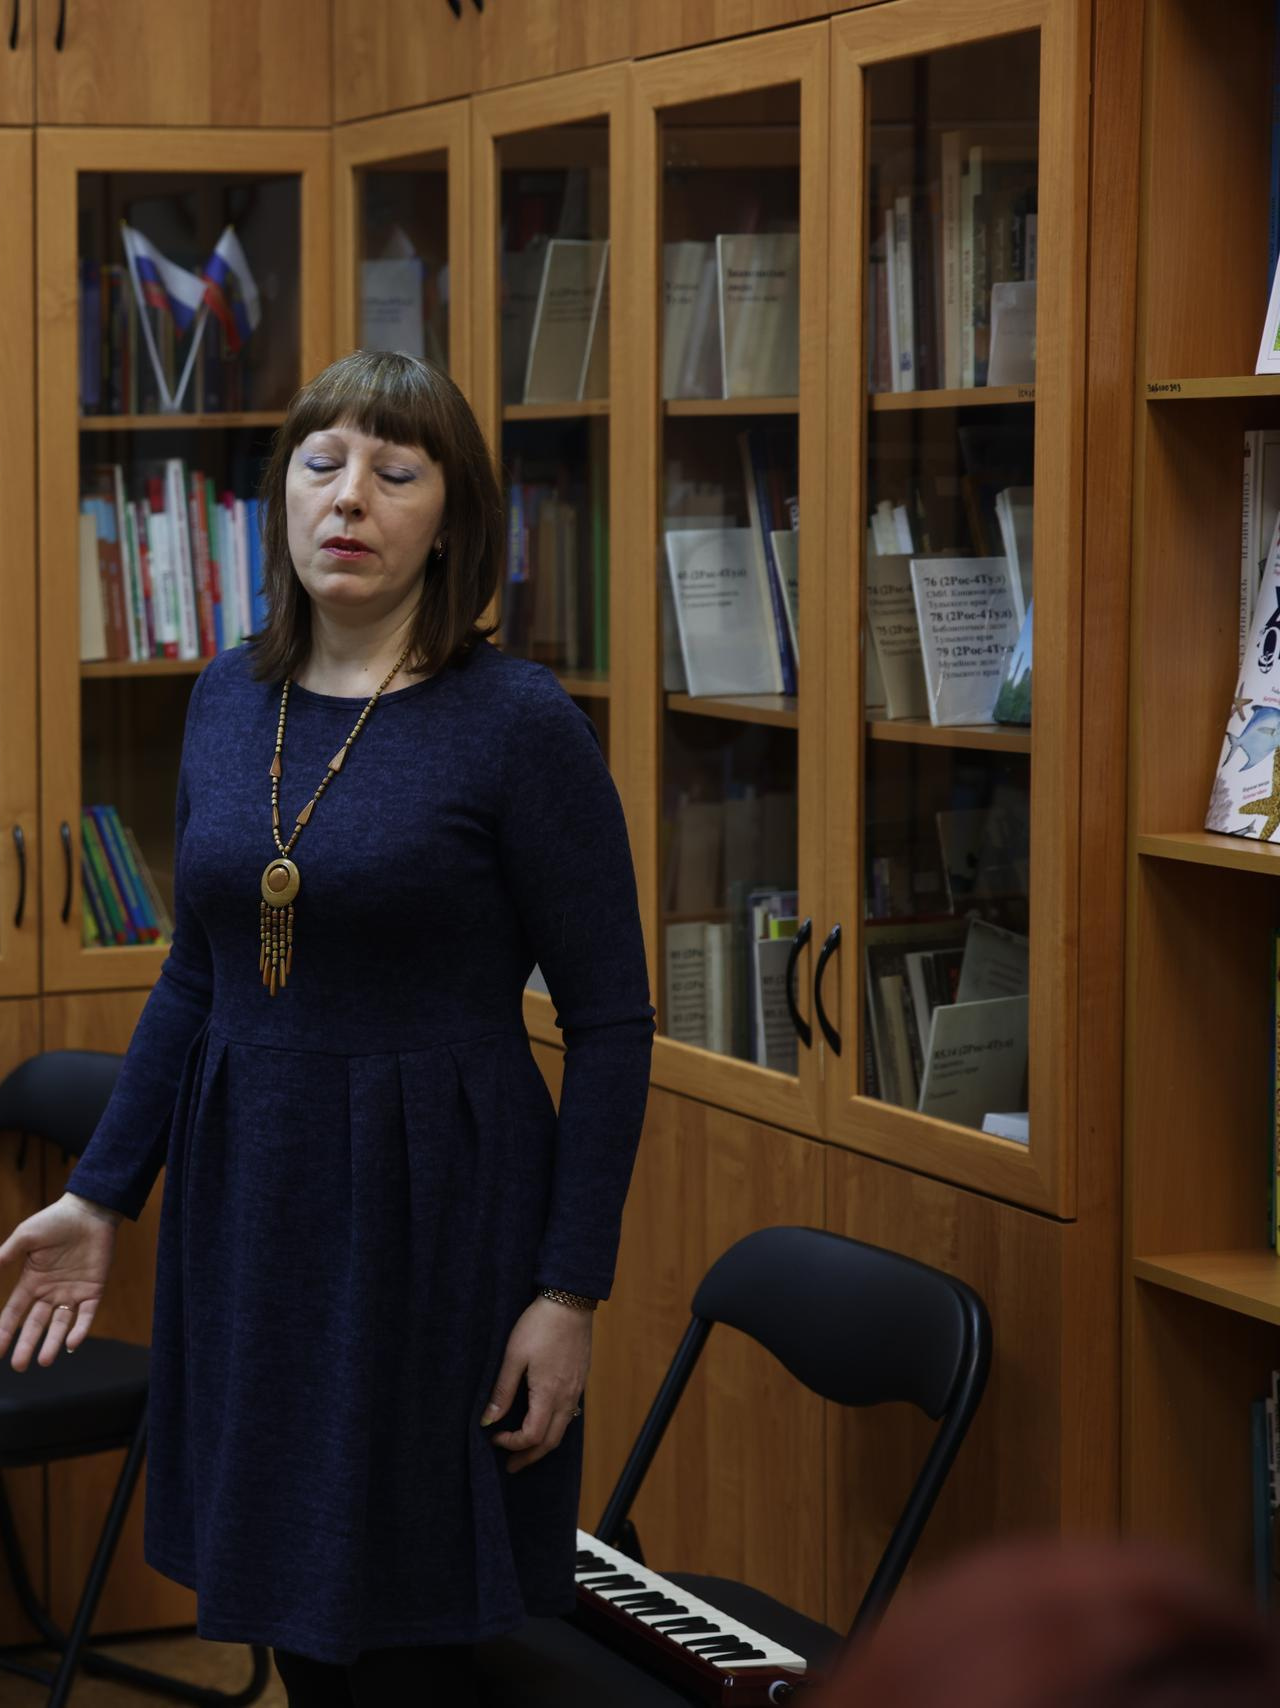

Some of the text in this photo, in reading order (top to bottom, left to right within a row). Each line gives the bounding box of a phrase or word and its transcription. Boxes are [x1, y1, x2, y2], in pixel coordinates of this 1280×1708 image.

[923, 577, 937, 587] 76
[930, 612, 943, 622] 78
[936, 647, 949, 657] 79
